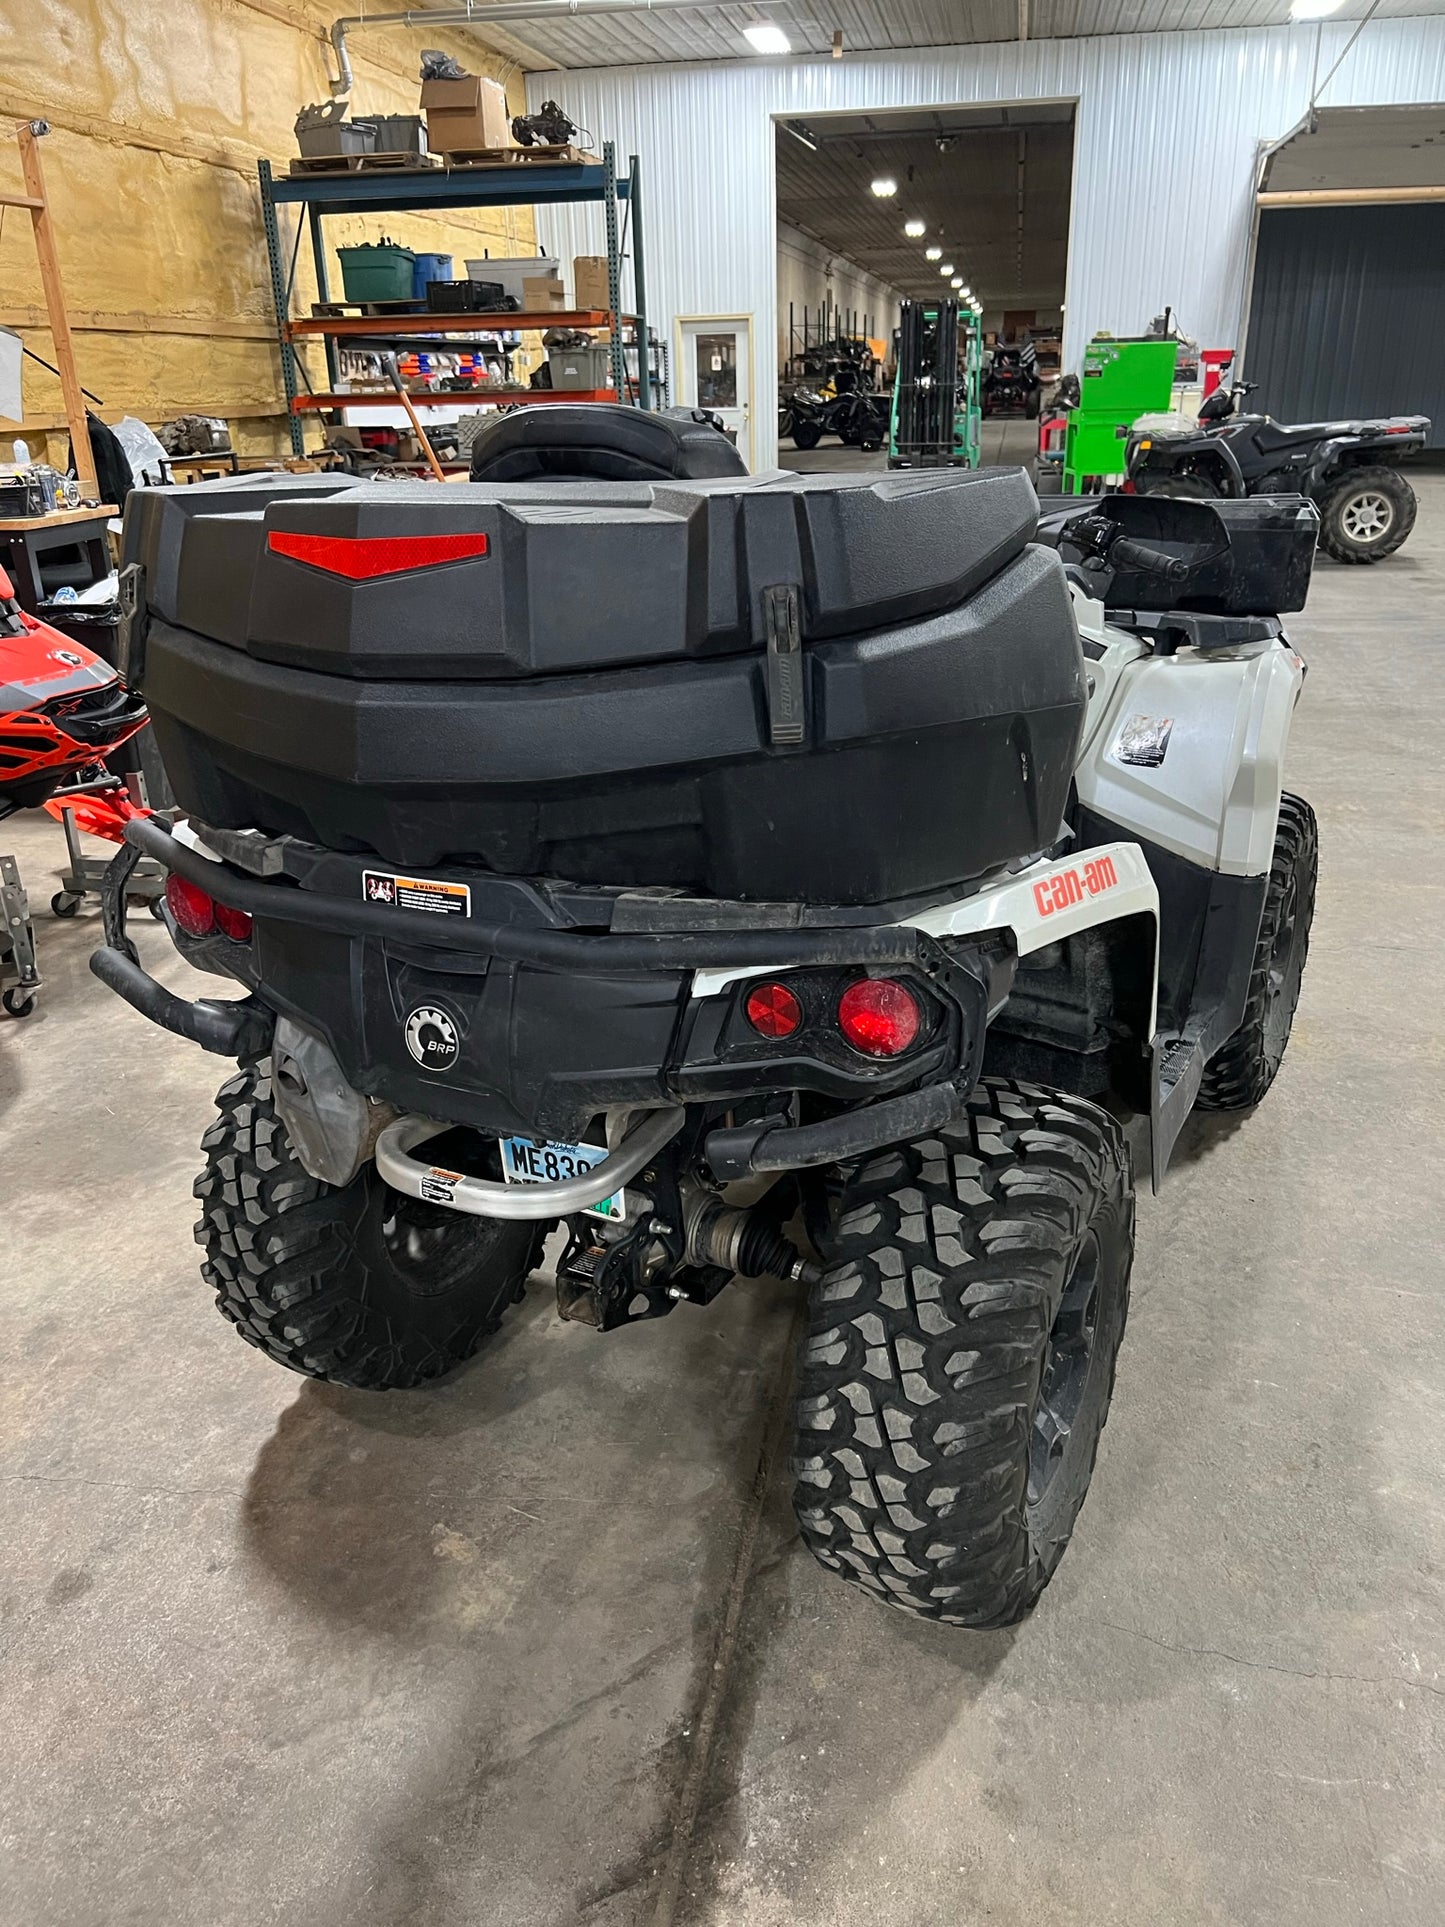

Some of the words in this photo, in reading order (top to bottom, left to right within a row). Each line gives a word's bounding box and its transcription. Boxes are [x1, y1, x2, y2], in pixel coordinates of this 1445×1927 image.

[419, 884, 449, 893] WARNING
[1033, 856, 1118, 917] can-am
[427, 1040, 456, 1055] BRP
